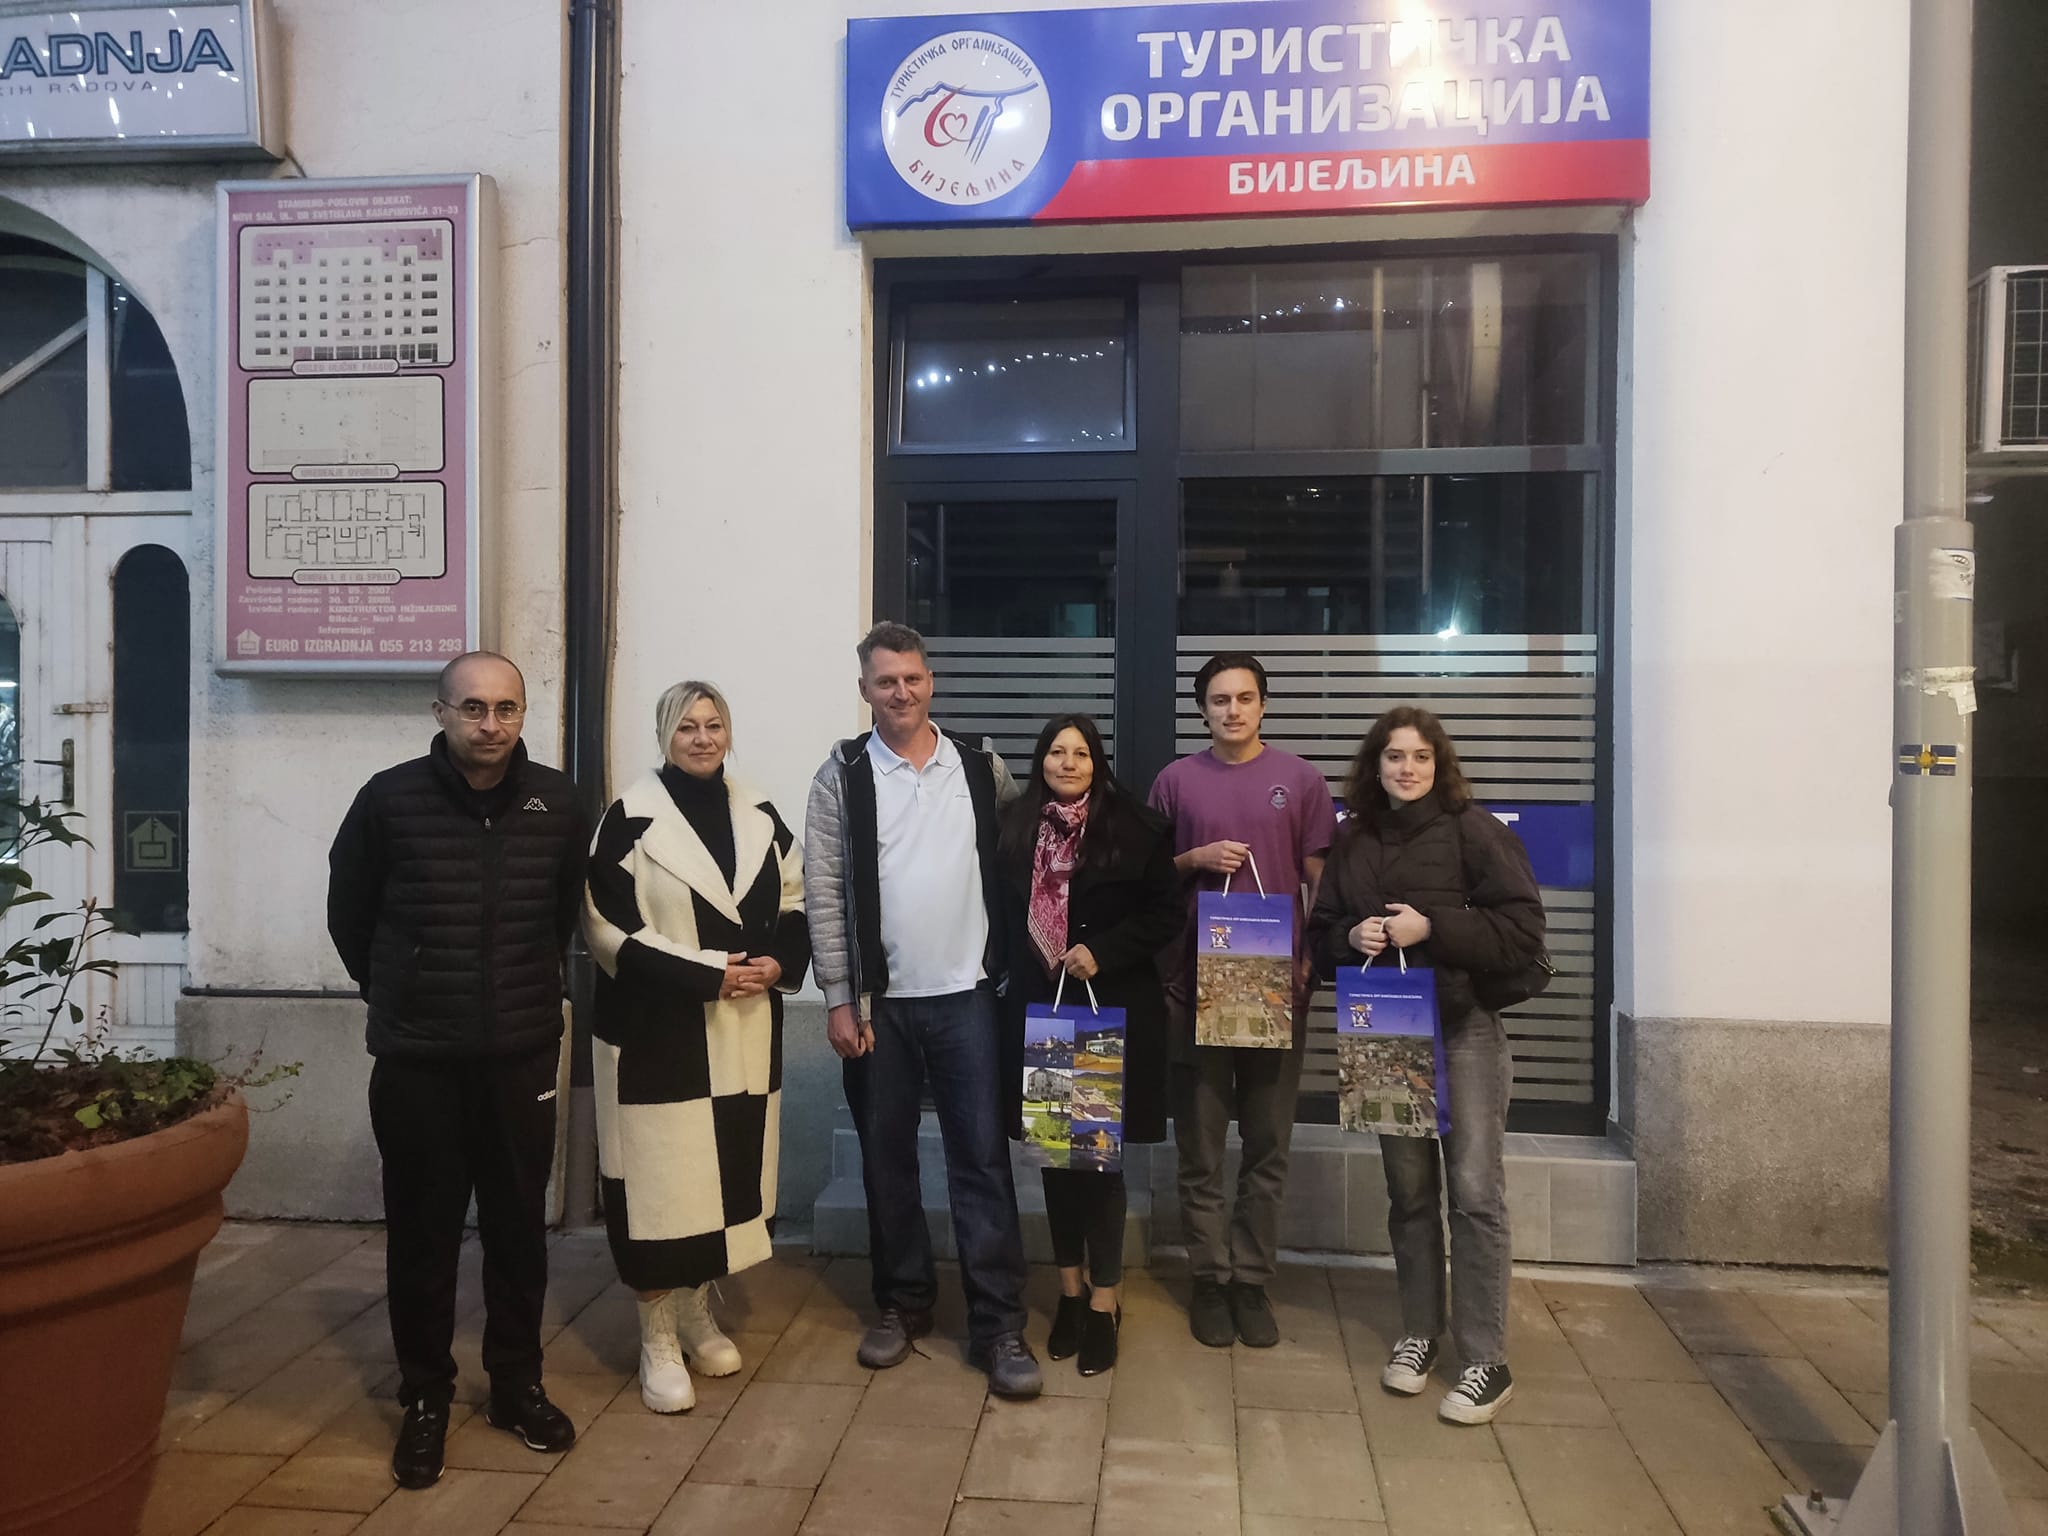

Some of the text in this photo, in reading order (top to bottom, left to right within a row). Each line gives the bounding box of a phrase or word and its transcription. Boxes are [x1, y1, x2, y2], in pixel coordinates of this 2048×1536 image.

[952, 37, 1033, 78] ОРГАНИЗАЦИЈА
[1137, 16, 1572, 79] ТУРИСТИЧКА
[891, 43, 947, 98] ТУРИСТИЧКА
[1101, 76, 1610, 141] ОРГАНИЗАЦИЈА
[908, 159, 1025, 197] БИЈЕЉИНА
[1229, 154, 1476, 195] БИЈЕЉИНА
[265, 638, 299, 652] EURO
[304, 638, 374, 652] IZGRADNJA
[409, 638, 433, 652] 213
